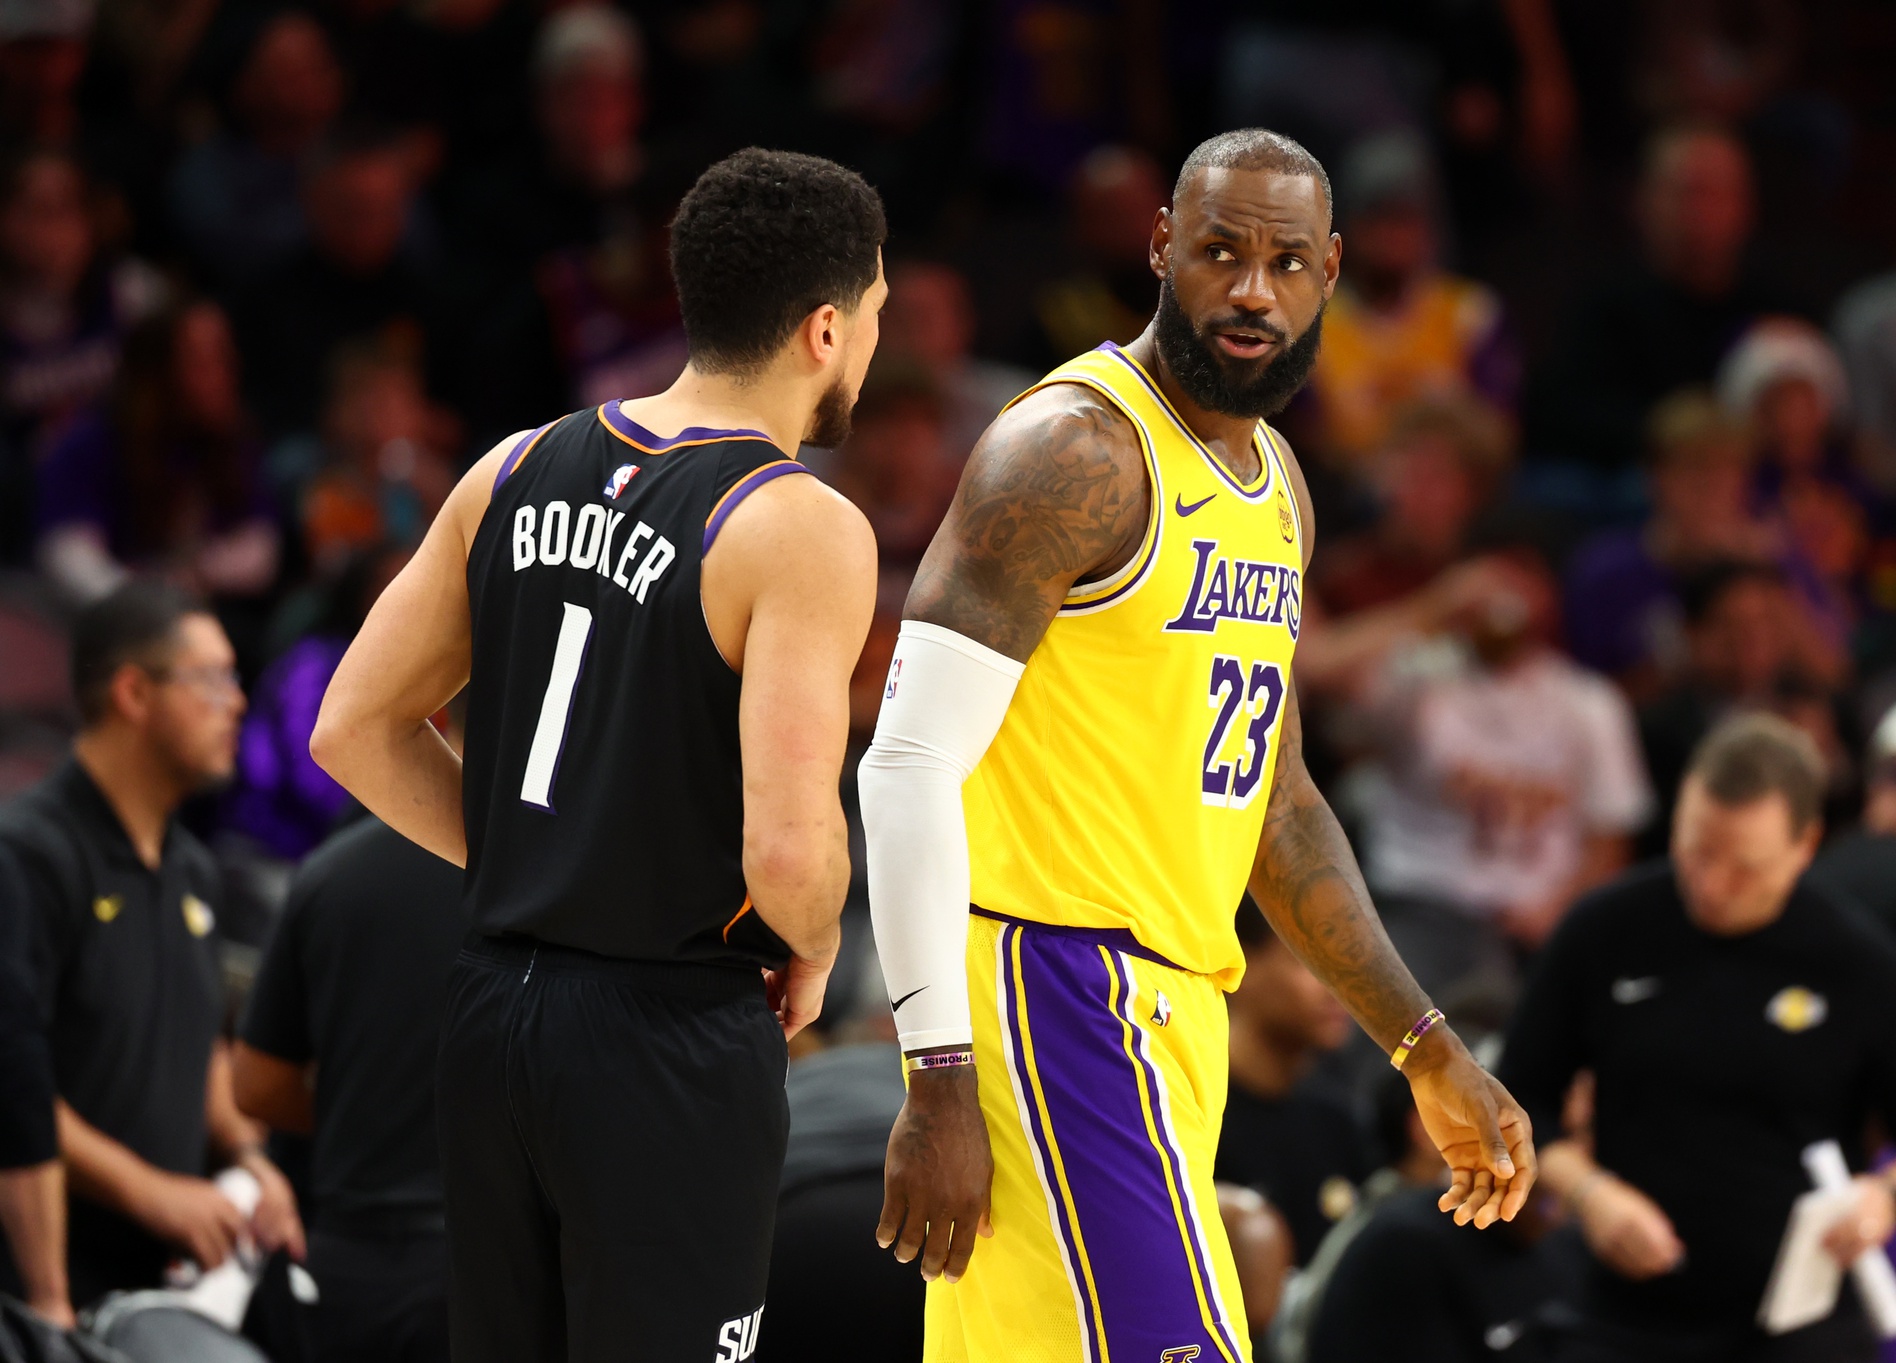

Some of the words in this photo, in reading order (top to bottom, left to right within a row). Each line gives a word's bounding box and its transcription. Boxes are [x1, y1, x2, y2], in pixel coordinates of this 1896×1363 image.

[513, 500, 675, 605] BOOKER
[1162, 538, 1301, 642] LAKERS
[520, 601, 594, 812] 1
[1201, 653, 1286, 811] 23
[921, 1055, 969, 1066] PROMISE
